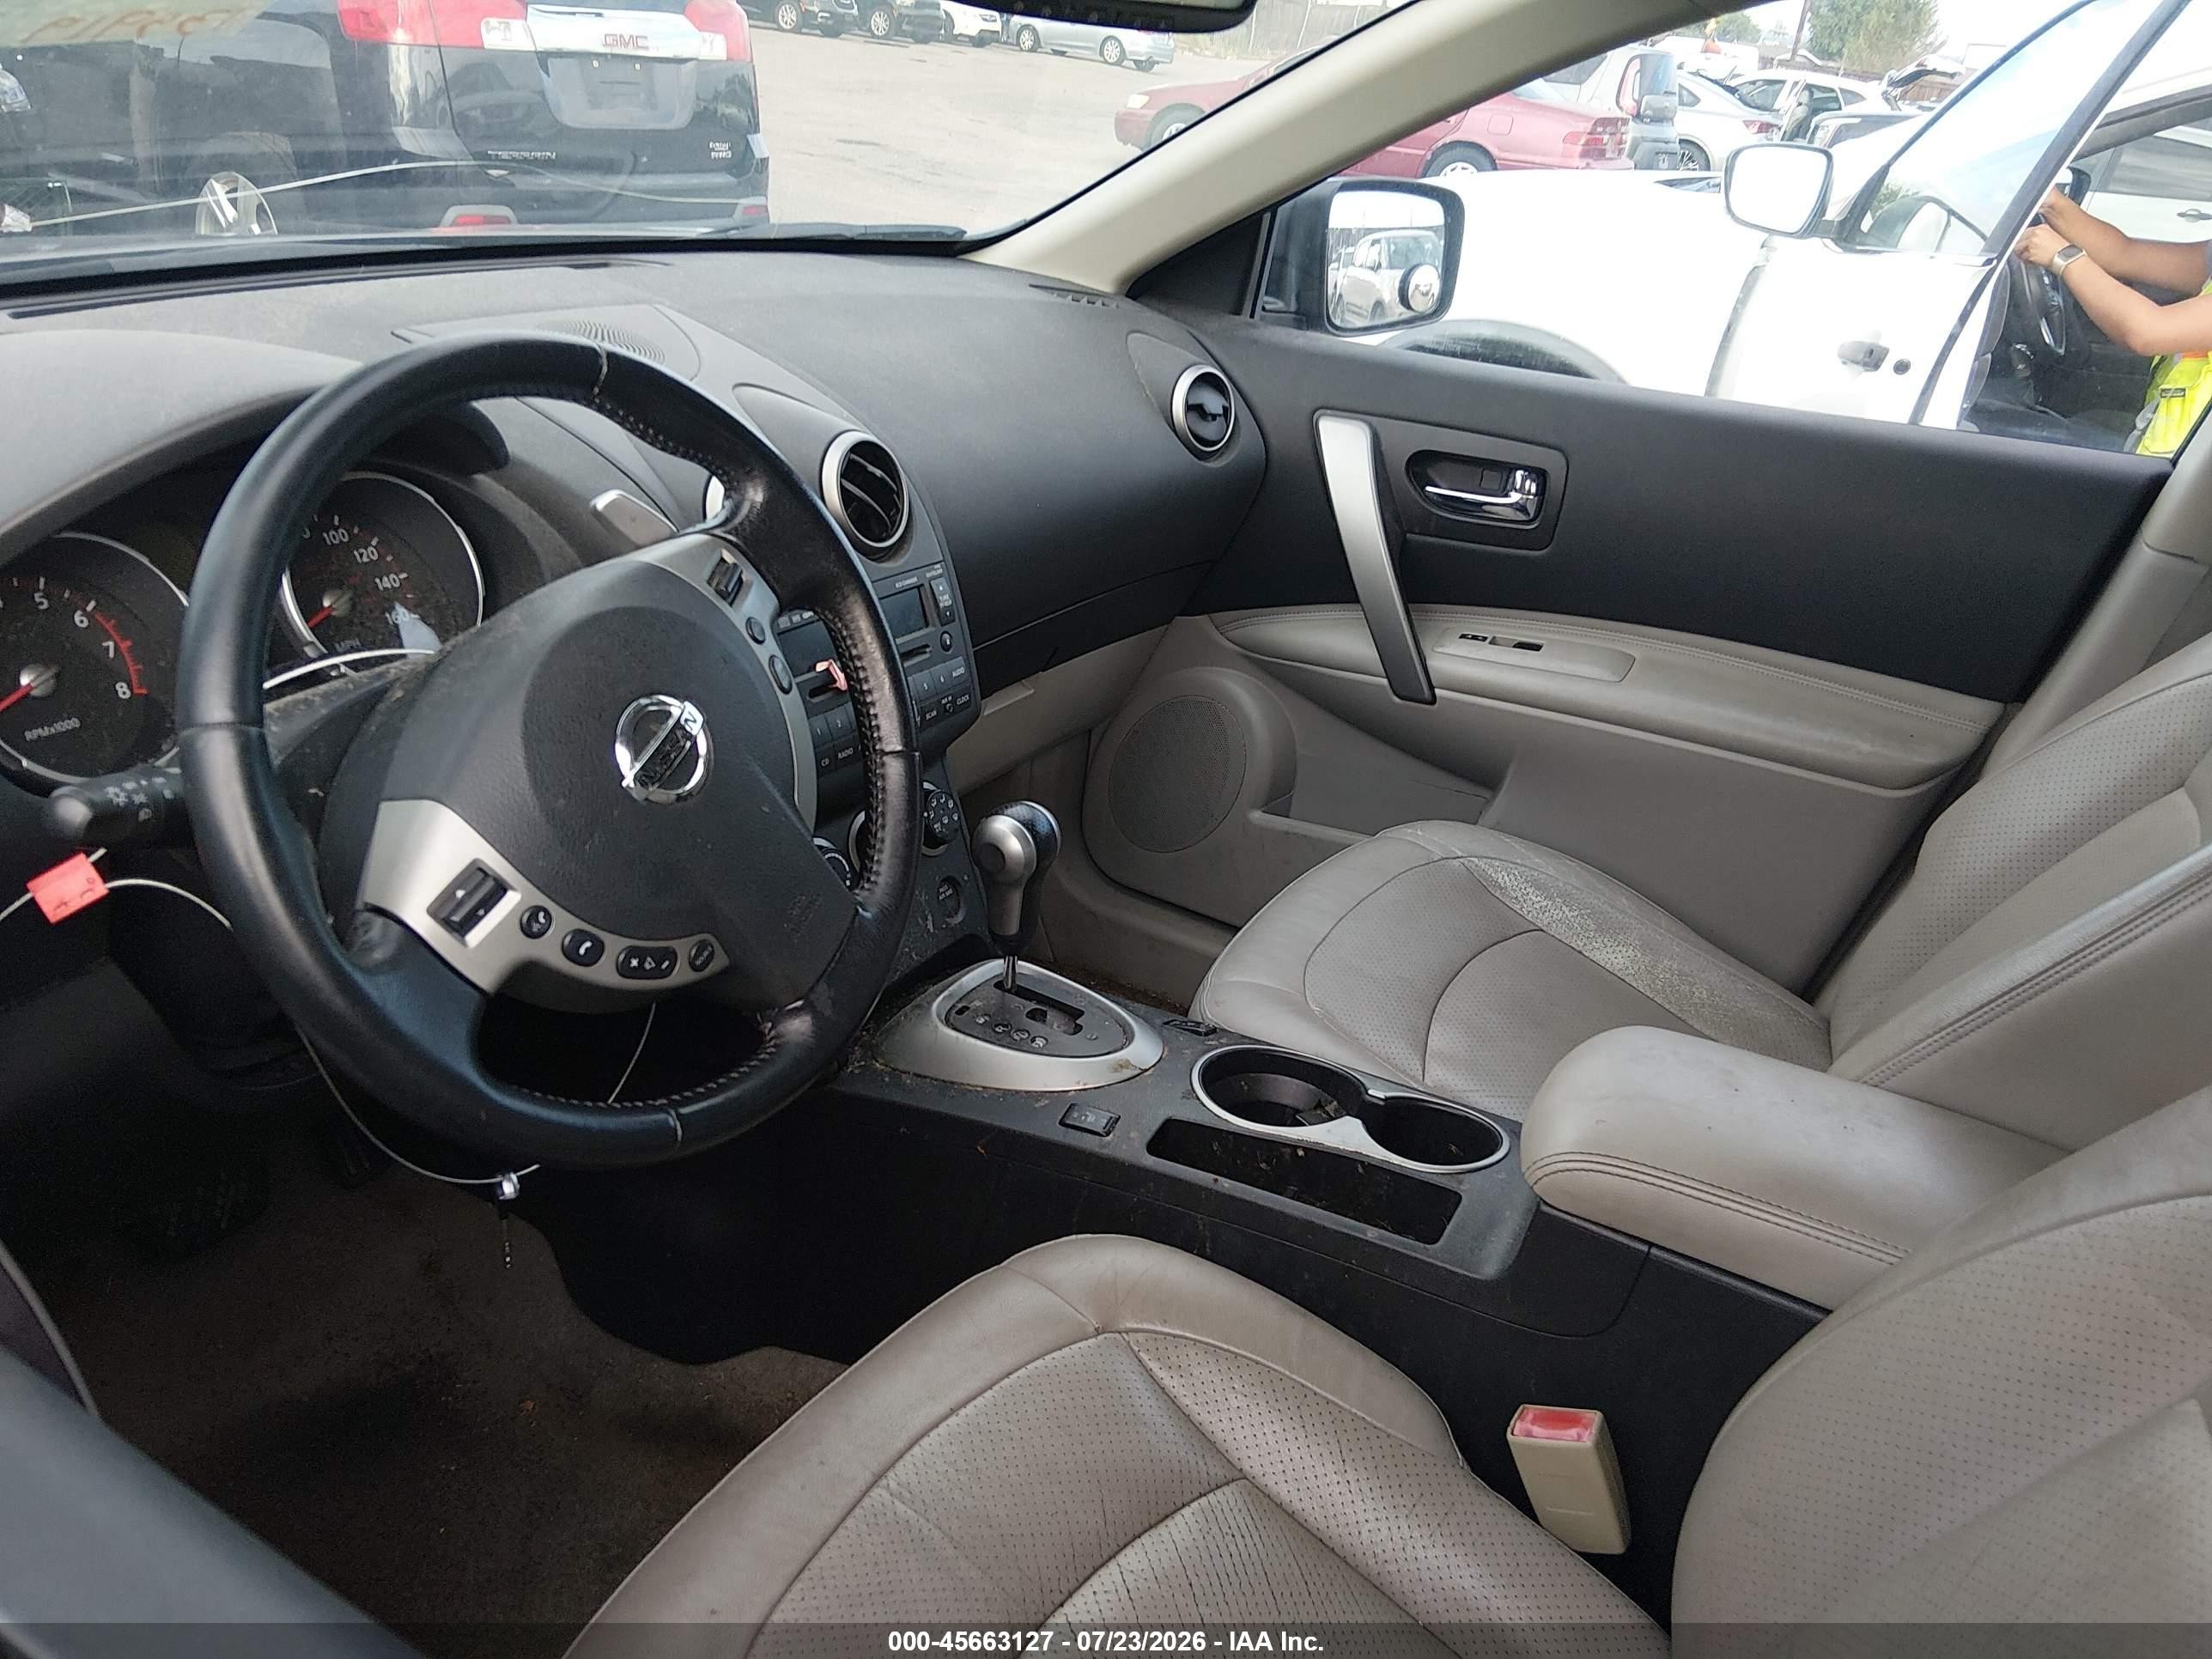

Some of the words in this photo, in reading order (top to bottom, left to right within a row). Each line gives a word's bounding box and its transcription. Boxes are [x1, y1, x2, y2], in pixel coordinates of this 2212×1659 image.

[603, 33, 649, 51] GMC
[323, 528, 349, 545] 100
[354, 545, 379, 563] 120
[374, 573, 400, 591] 140
[33, 592, 49, 610] 5
[74, 611, 88, 628] 6
[386, 609, 410, 625] 160
[102, 641, 115, 659] 7
[952, 666, 965, 678] AUDIO
[115, 682, 131, 699] 8
[957, 694, 970, 705] CLOCK
[926, 710, 938, 720] SCAN
[837, 747, 854, 759] RADIO
[821, 757, 830, 767] CD
